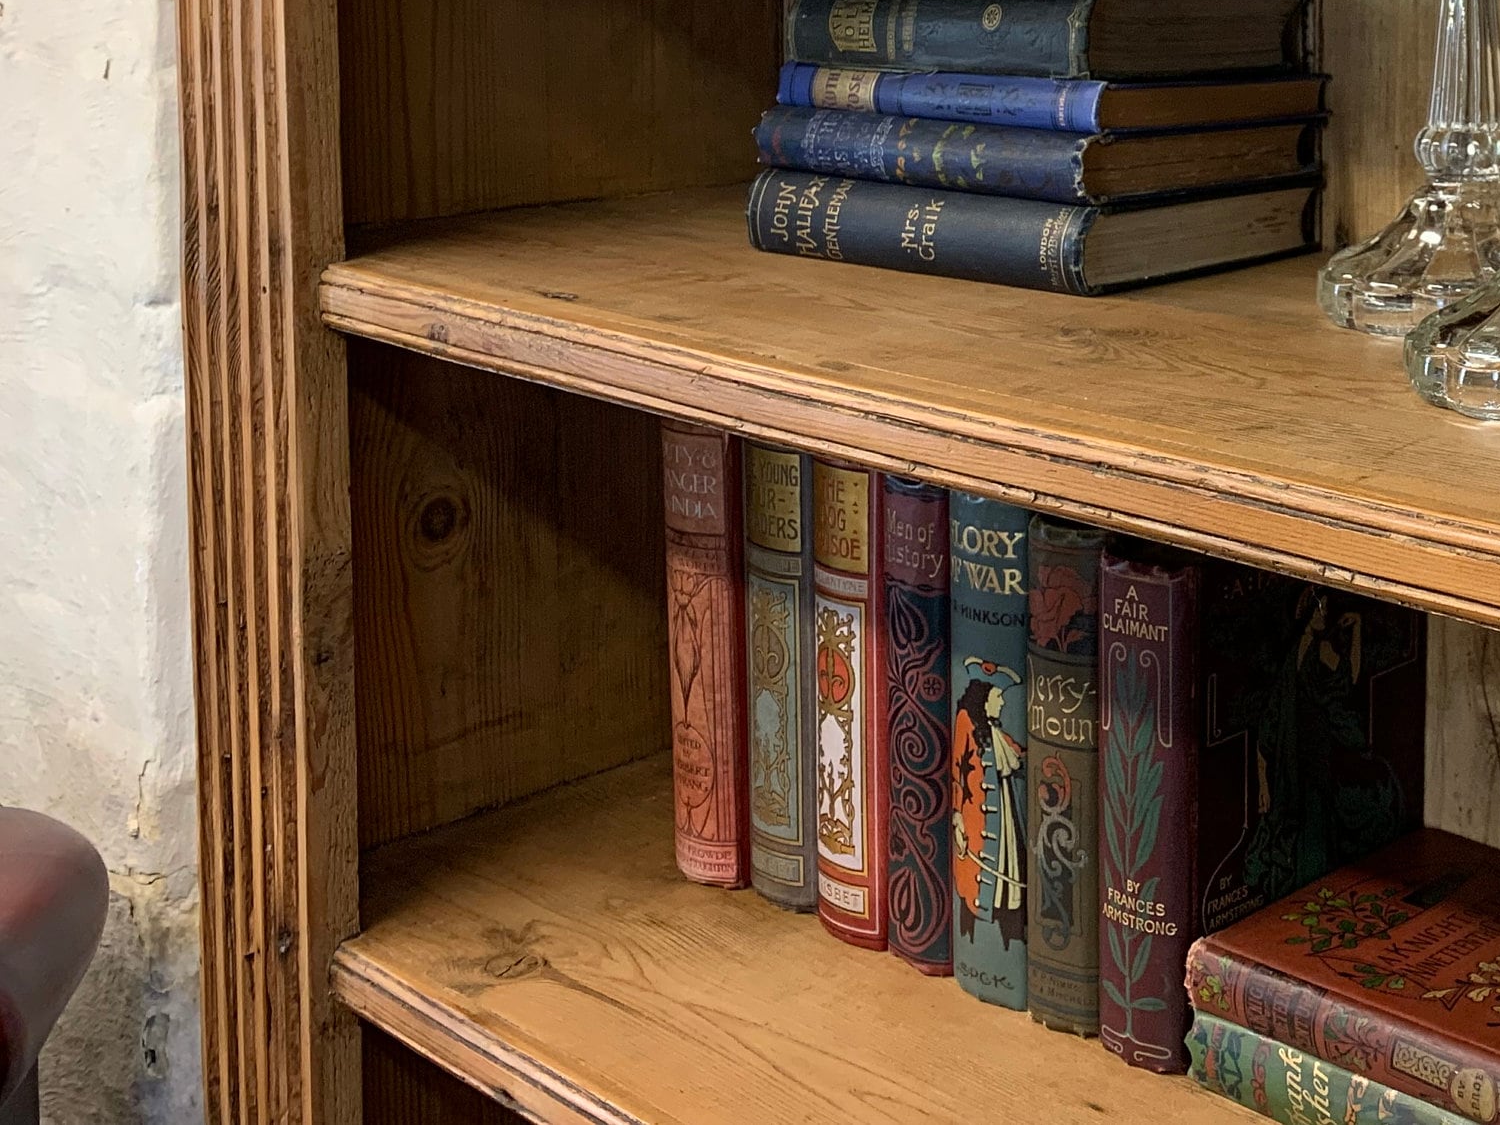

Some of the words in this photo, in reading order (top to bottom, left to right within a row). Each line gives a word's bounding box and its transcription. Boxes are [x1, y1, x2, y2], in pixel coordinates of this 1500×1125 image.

[770, 181, 797, 242] JOHN
[796, 176, 830, 259] HALIFAX
[1040, 218, 1054, 271] LONDON
[760, 458, 799, 486] YOUNG
[817, 532, 862, 561] USOE
[917, 523, 936, 551] of
[963, 560, 1028, 596] WAR
[1126, 585, 1139, 602] A
[1114, 598, 1149, 622] FAIR
[1103, 612, 1169, 643] CLAIMANT
[1107, 887, 1166, 917] FRANCES
[1126, 878, 1141, 895] BY
[1207, 884, 1249, 916] FRANCES
[1102, 902, 1178, 937] ARMSTRONG
[1279, 1046, 1313, 1125] rank
